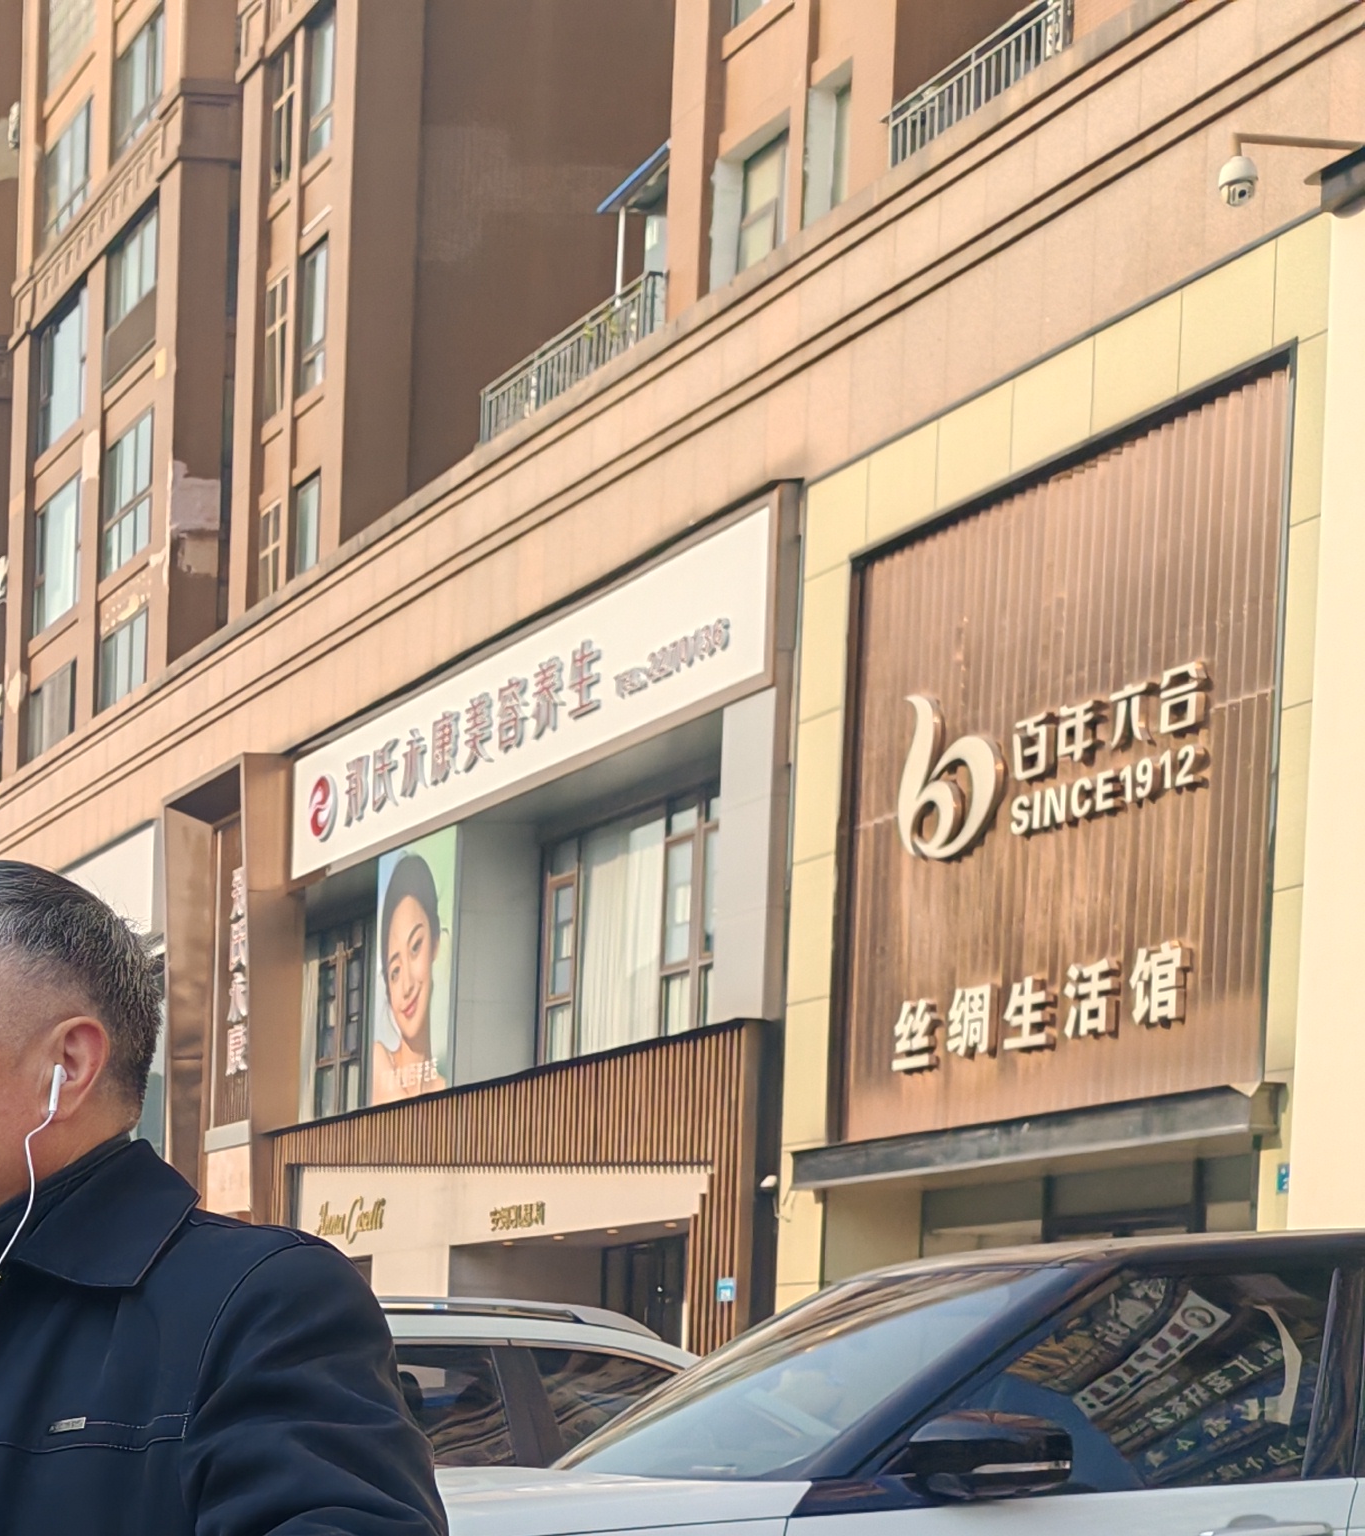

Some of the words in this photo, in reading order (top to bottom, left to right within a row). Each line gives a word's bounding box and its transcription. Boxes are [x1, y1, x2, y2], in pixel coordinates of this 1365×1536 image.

[1014, 661, 1211, 782] 百年六合
[892, 940, 1189, 1071] 丝绸生活馆
